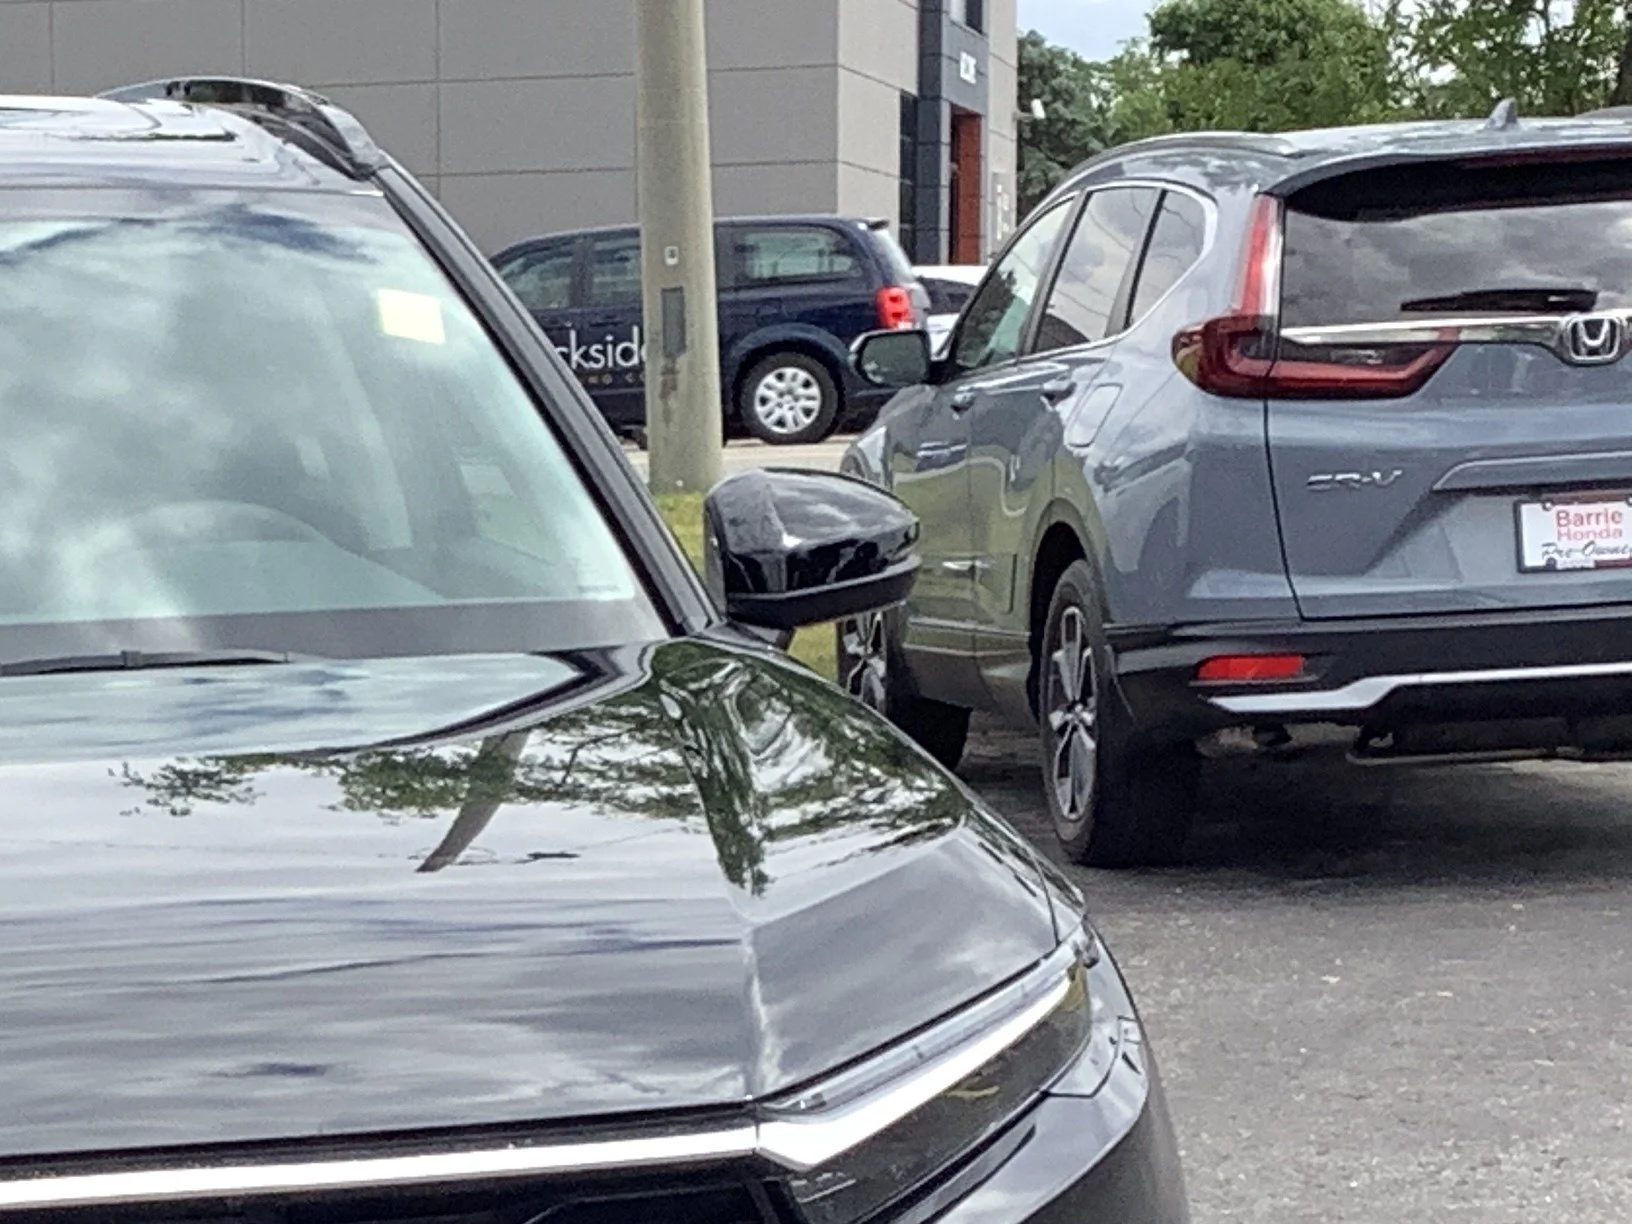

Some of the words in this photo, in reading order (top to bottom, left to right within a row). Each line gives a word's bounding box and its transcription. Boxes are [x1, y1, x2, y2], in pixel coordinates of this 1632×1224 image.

[552, 325, 647, 370] ksid
[1556, 508, 1624, 528] Barrie
[1557, 527, 1624, 541] Honda
